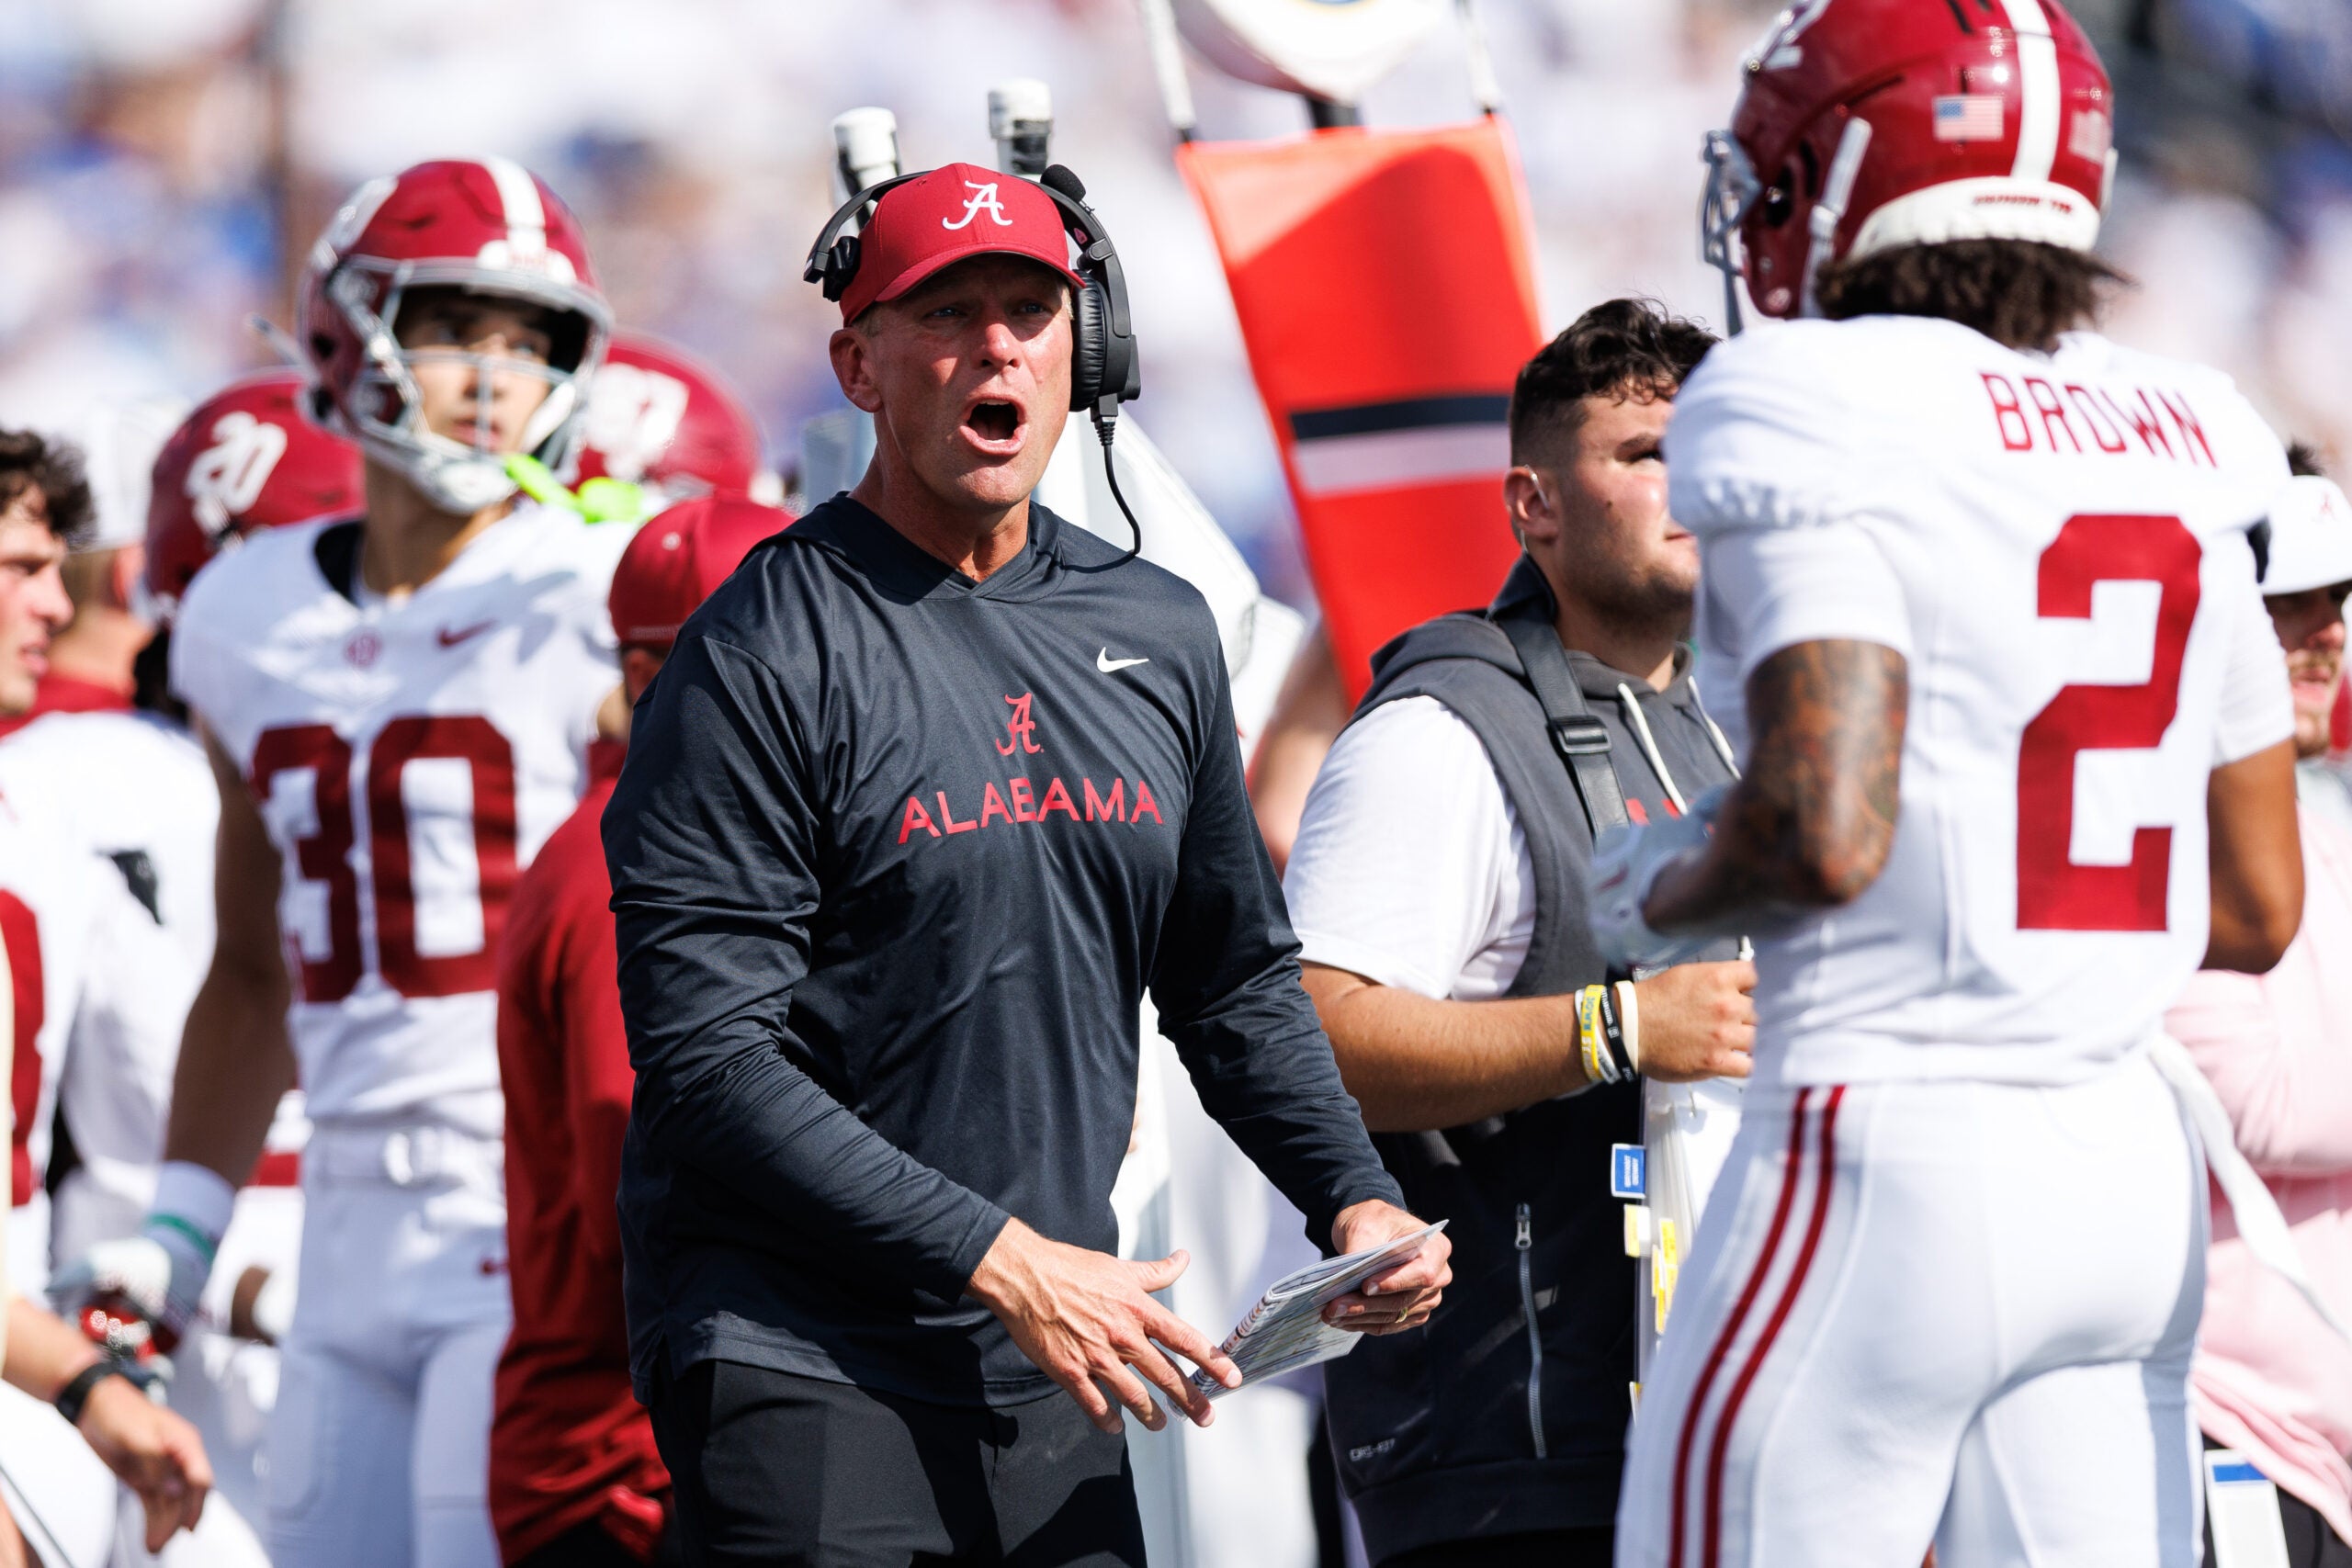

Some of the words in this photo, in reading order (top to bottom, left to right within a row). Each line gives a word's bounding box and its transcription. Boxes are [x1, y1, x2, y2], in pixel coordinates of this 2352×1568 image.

[942, 180, 1013, 231] A
[1979, 372, 2218, 468] BROWN
[996, 692, 1041, 756] A
[2016, 513, 2204, 932] 2
[898, 777, 1163, 844] ALABAMA
[251, 716, 518, 1004] 30
